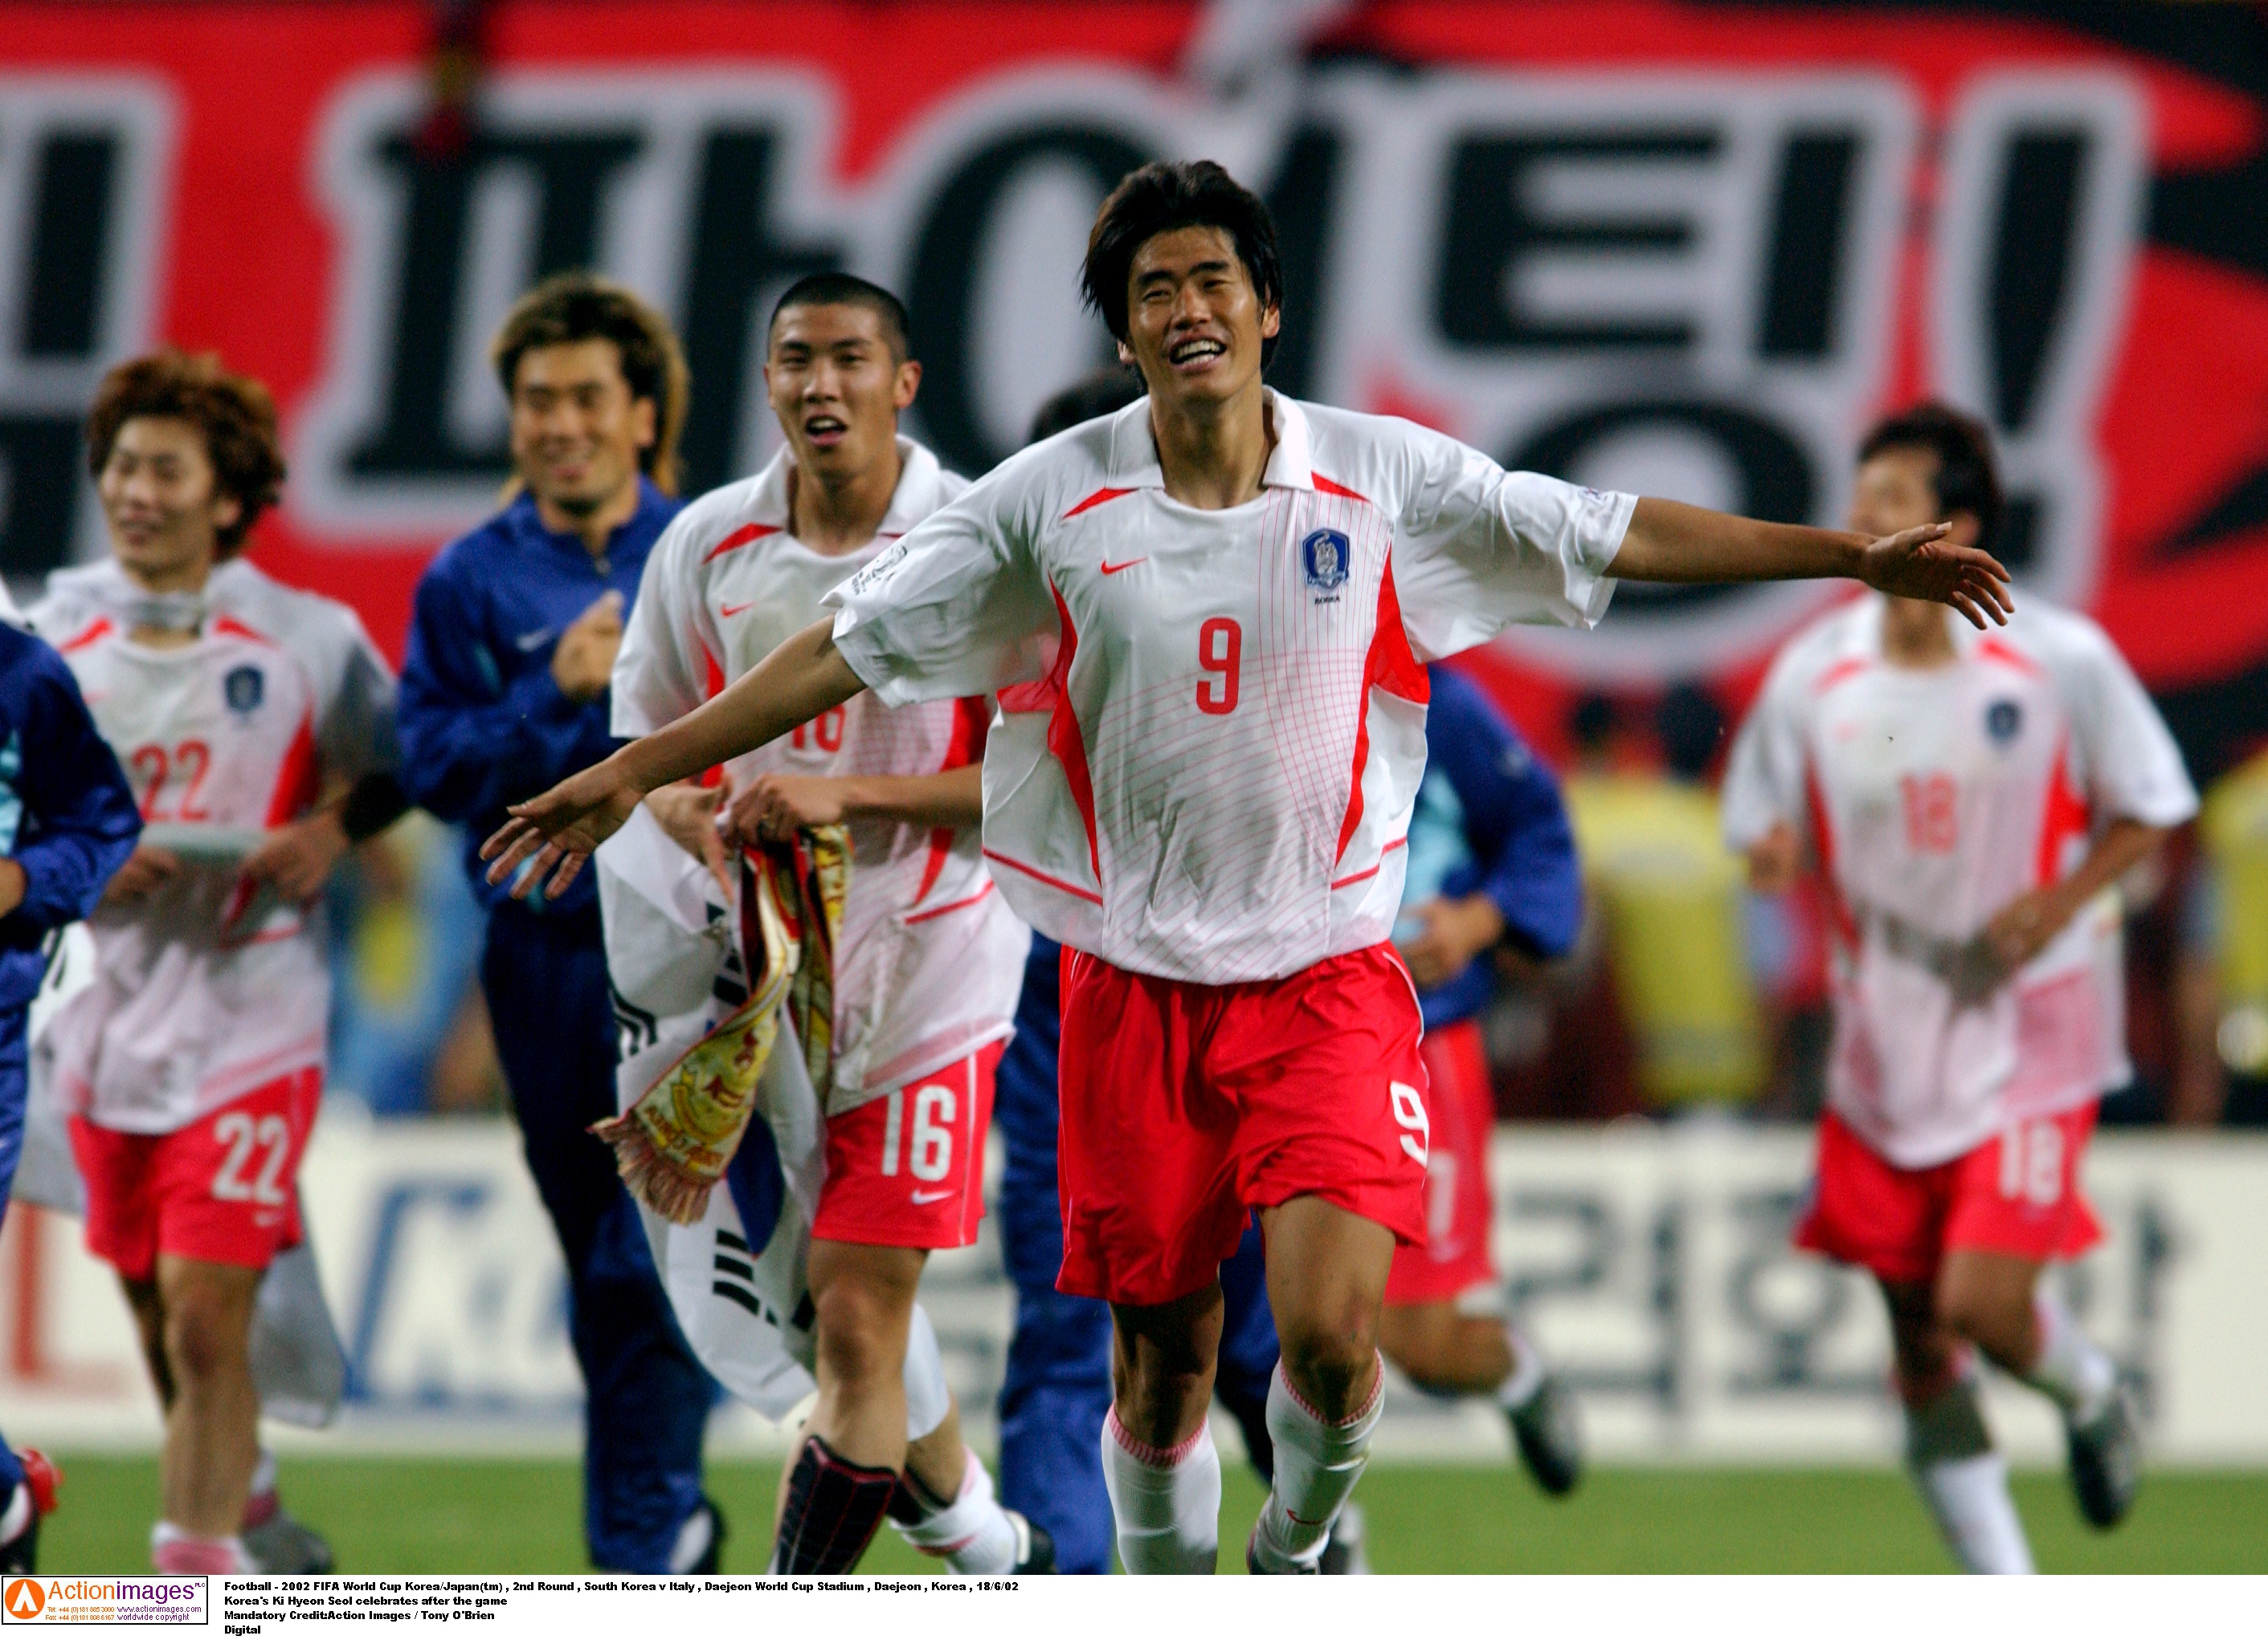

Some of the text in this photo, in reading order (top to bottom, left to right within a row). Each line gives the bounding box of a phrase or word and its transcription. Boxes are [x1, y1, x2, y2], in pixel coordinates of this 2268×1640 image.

[1195, 617, 1242, 715] 9
[132, 740, 210, 821] 22
[212, 1112, 288, 1205] 22
[881, 1085, 958, 1182] 16
[1390, 1080, 1430, 1170] 9
